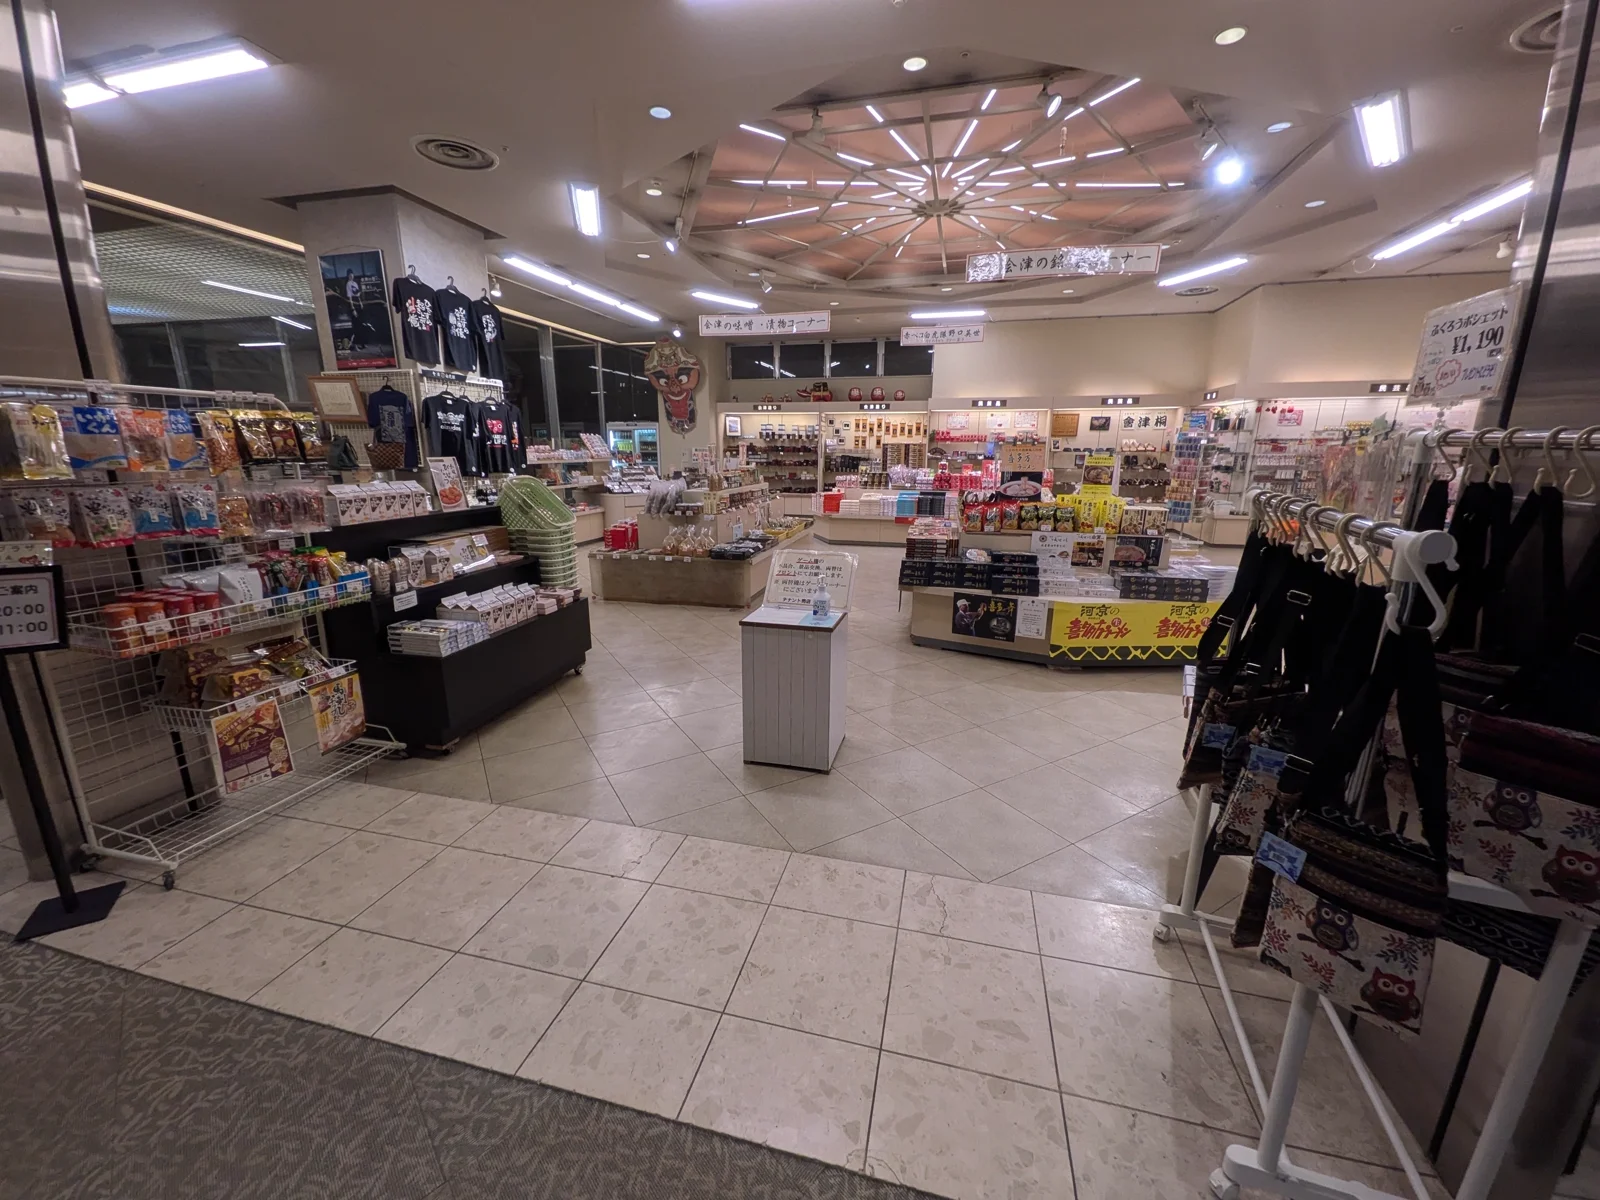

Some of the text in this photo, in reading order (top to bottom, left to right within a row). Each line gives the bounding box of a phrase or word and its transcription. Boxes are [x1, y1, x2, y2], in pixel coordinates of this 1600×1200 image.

[1005, 250, 1152, 273] 会津の銘ーナー
[0, 603, 44, 617] 0:00
